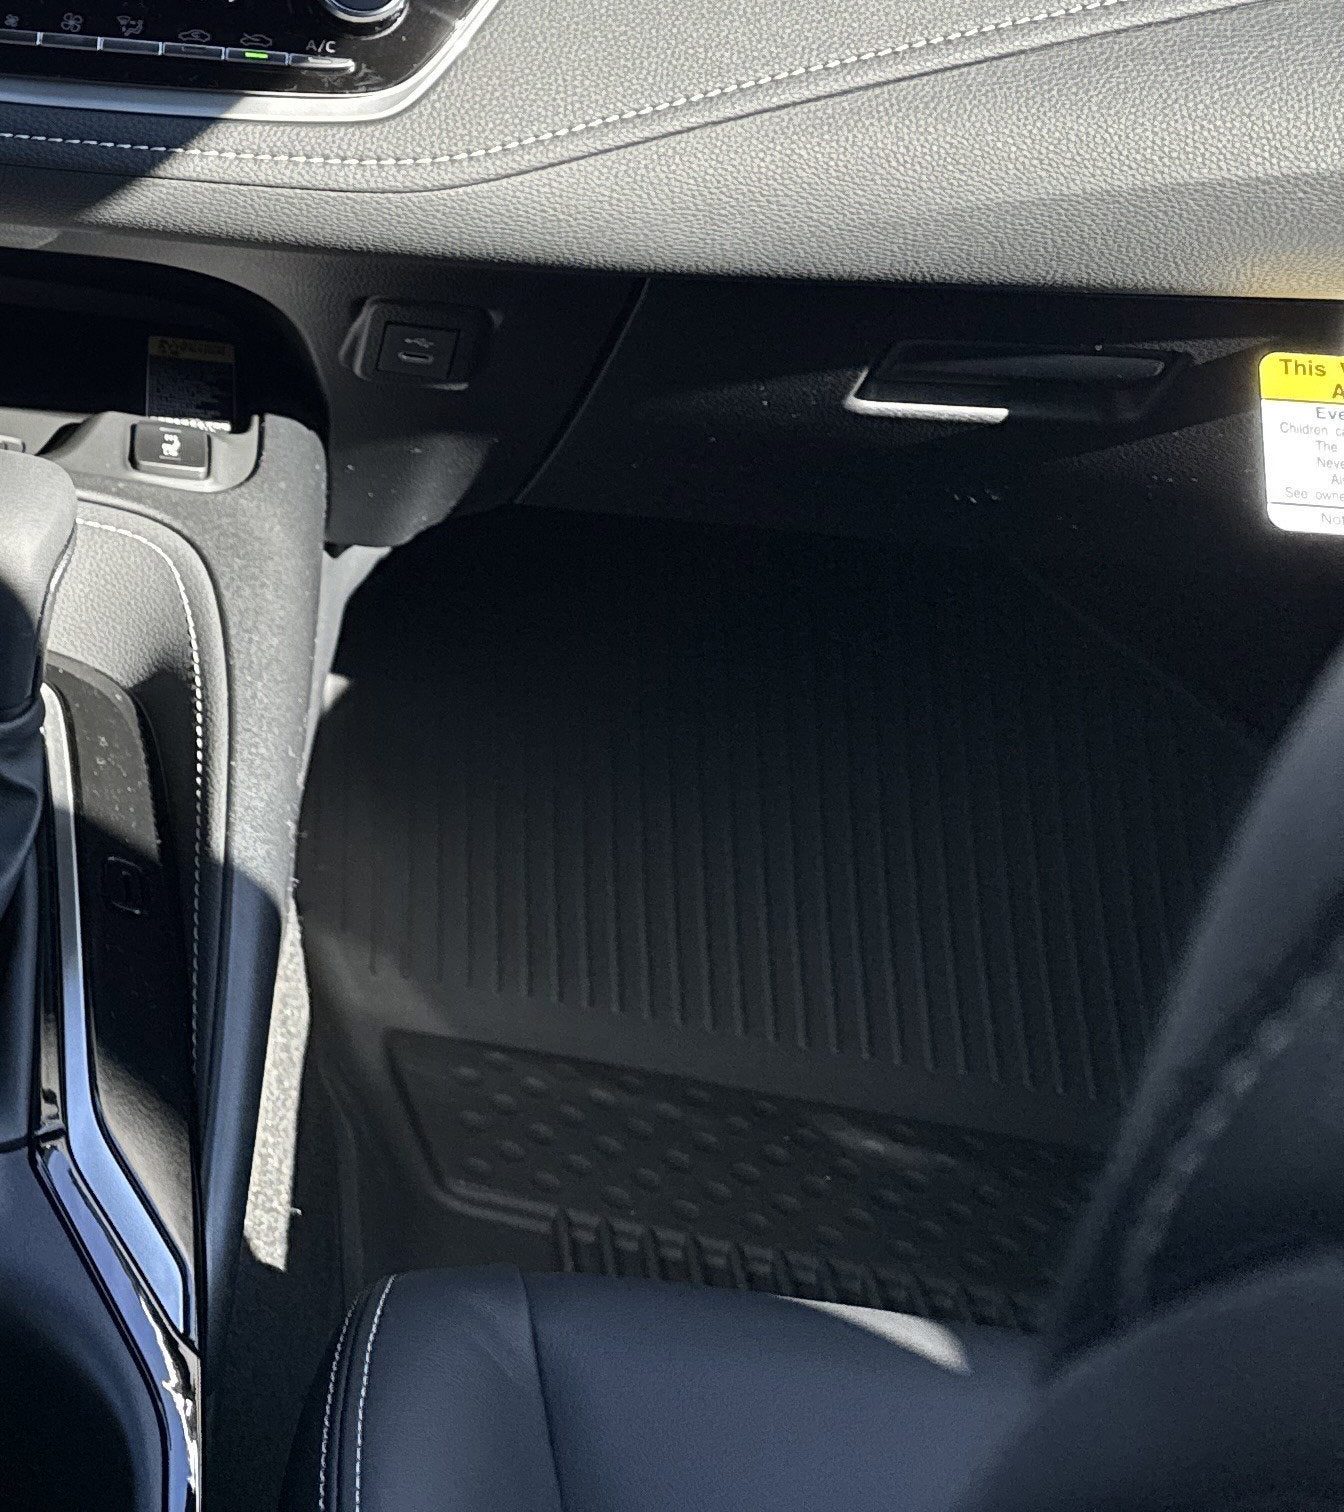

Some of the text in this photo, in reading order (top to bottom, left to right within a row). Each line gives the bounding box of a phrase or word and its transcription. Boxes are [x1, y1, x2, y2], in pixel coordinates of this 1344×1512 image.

[306, 39, 337, 54] A/C
[1278, 358, 1327, 377] This
[1280, 421, 1328, 436] Children
[1315, 440, 1338, 453] The
[1285, 487, 1308, 499] See
